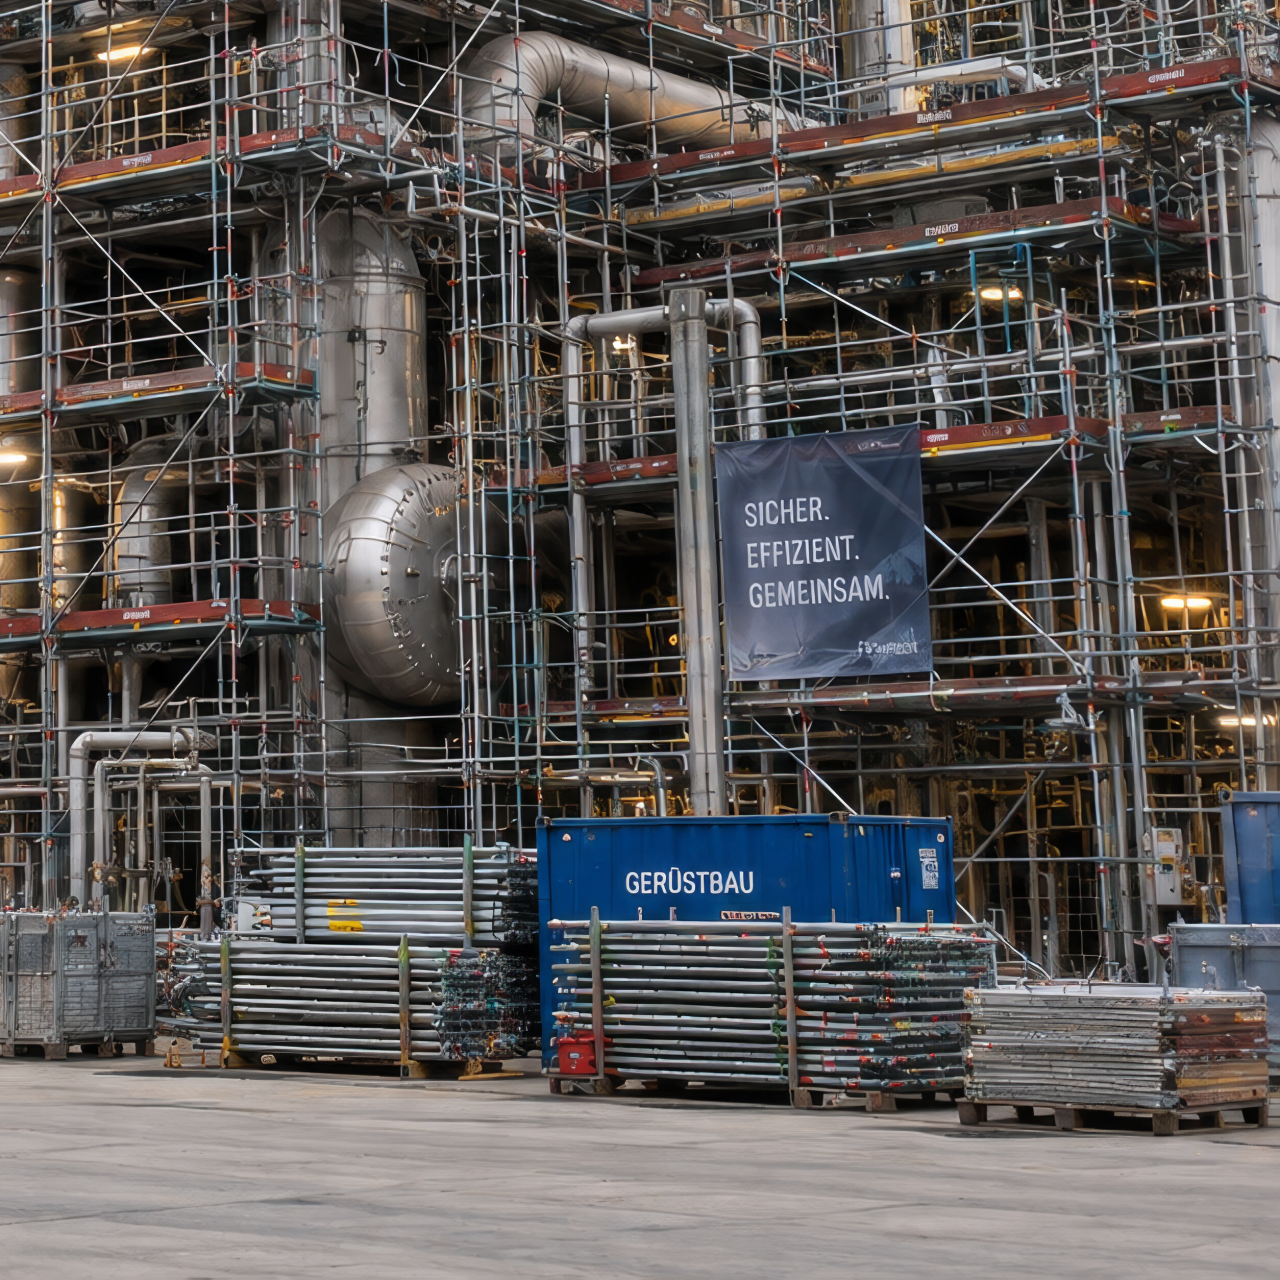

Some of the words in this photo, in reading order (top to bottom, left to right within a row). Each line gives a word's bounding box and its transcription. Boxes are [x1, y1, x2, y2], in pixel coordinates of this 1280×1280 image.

[744, 496, 830, 528] SICHER.
[746, 534, 860, 569] EFFIZIENT.
[748, 573, 890, 608] GEMEINSAM.
[625, 866, 755, 895] GERÜSTBAU
